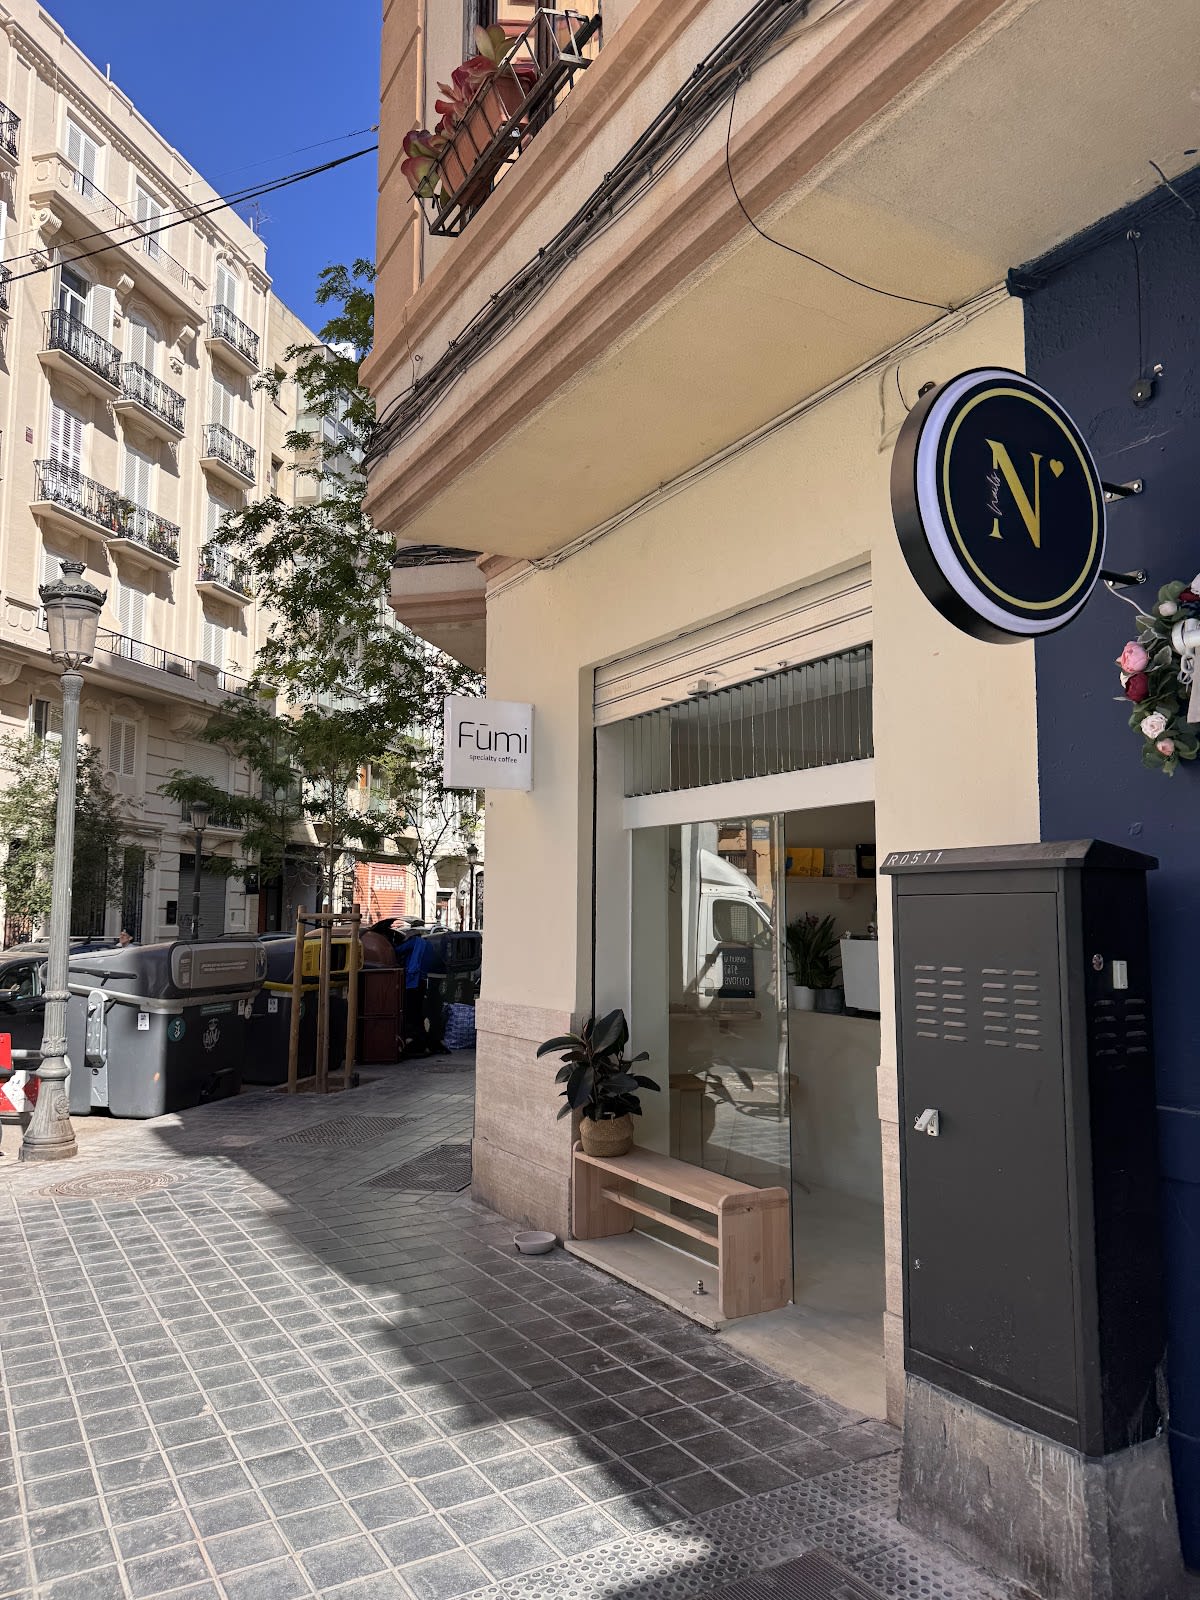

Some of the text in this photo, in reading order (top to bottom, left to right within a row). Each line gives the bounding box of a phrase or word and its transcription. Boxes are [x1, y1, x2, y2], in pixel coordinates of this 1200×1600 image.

[985, 439, 1043, 548] N
[469, 754, 518, 764] specialty coffee
